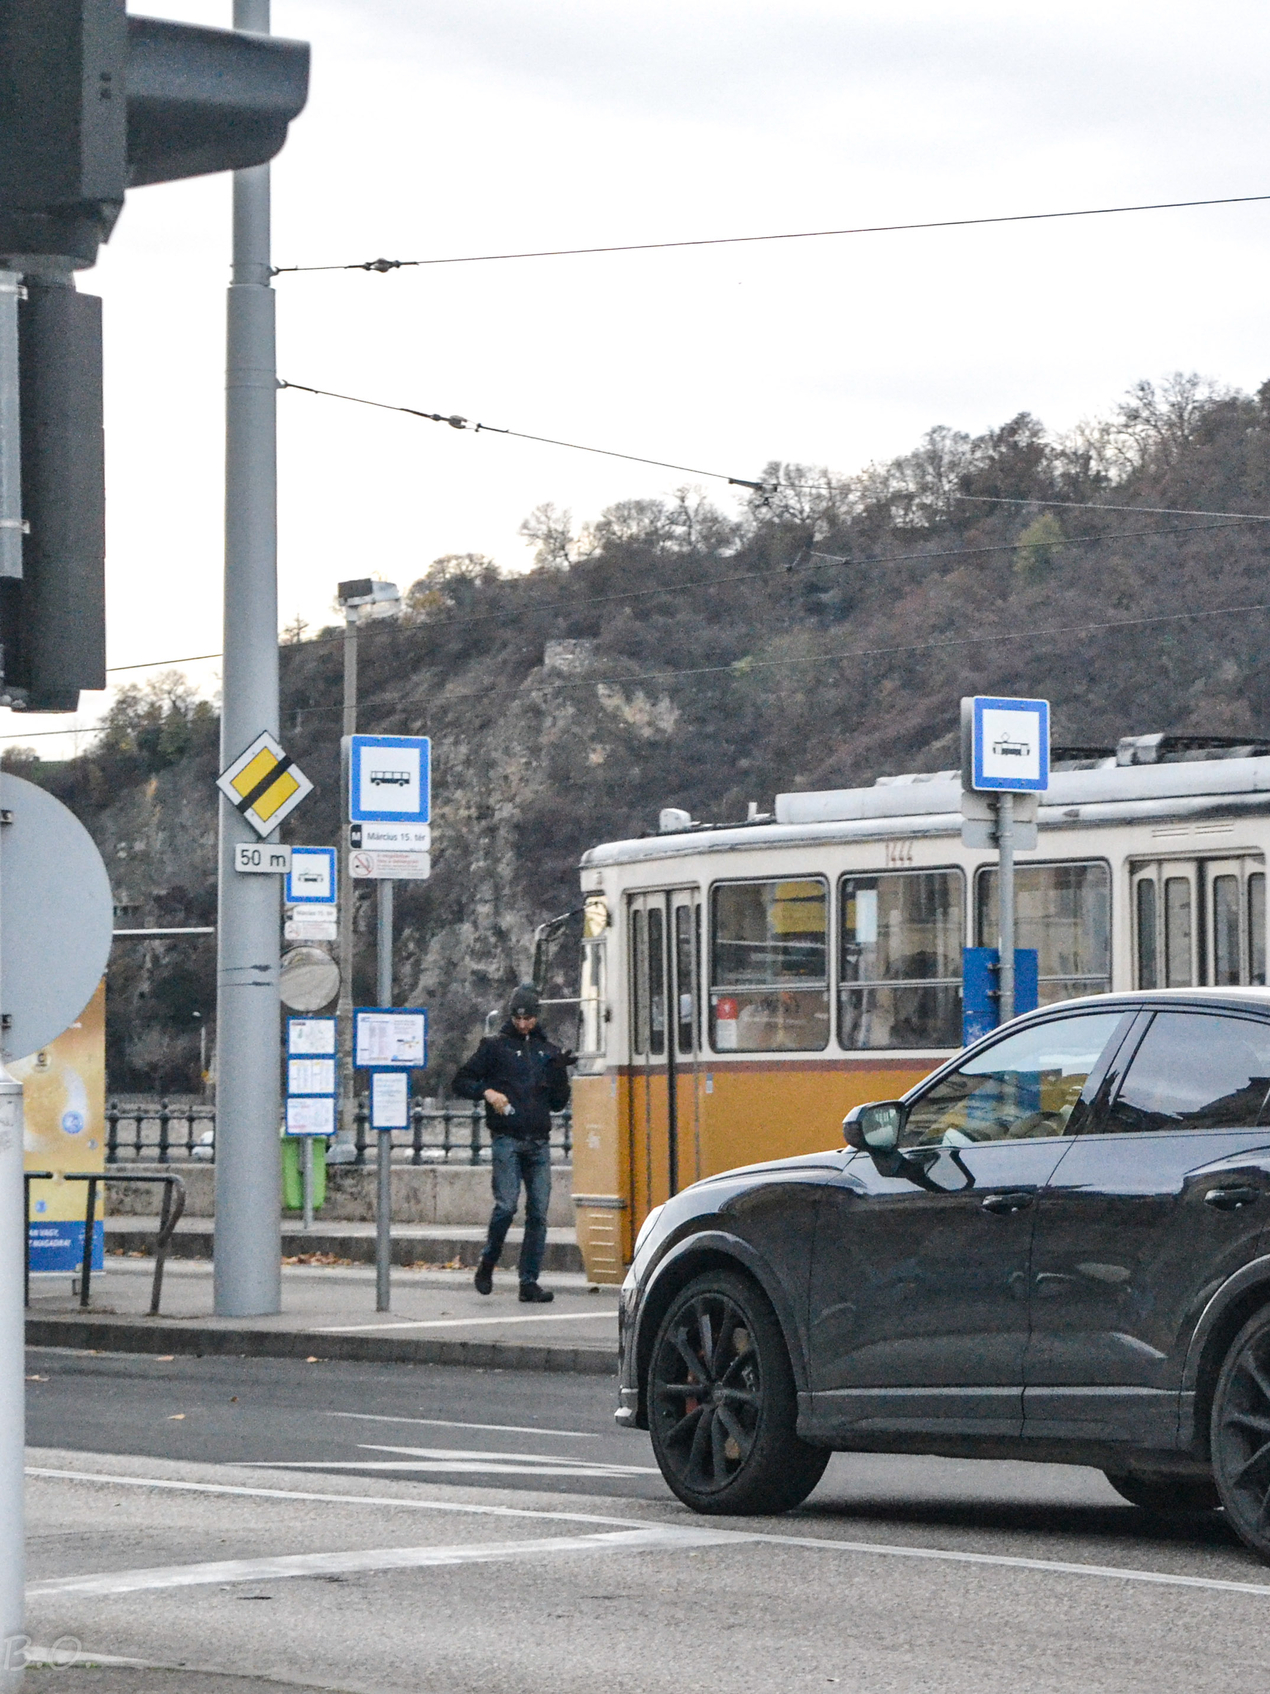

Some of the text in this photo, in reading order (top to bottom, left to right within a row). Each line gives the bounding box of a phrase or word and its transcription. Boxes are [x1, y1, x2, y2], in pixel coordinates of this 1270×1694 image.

[367, 832, 398, 841] Március
[400, 832, 413, 841] 15.
[414, 832, 426, 841] tér
[241, 849, 286, 867] 50 m
[885, 840, 913, 865] 1444
